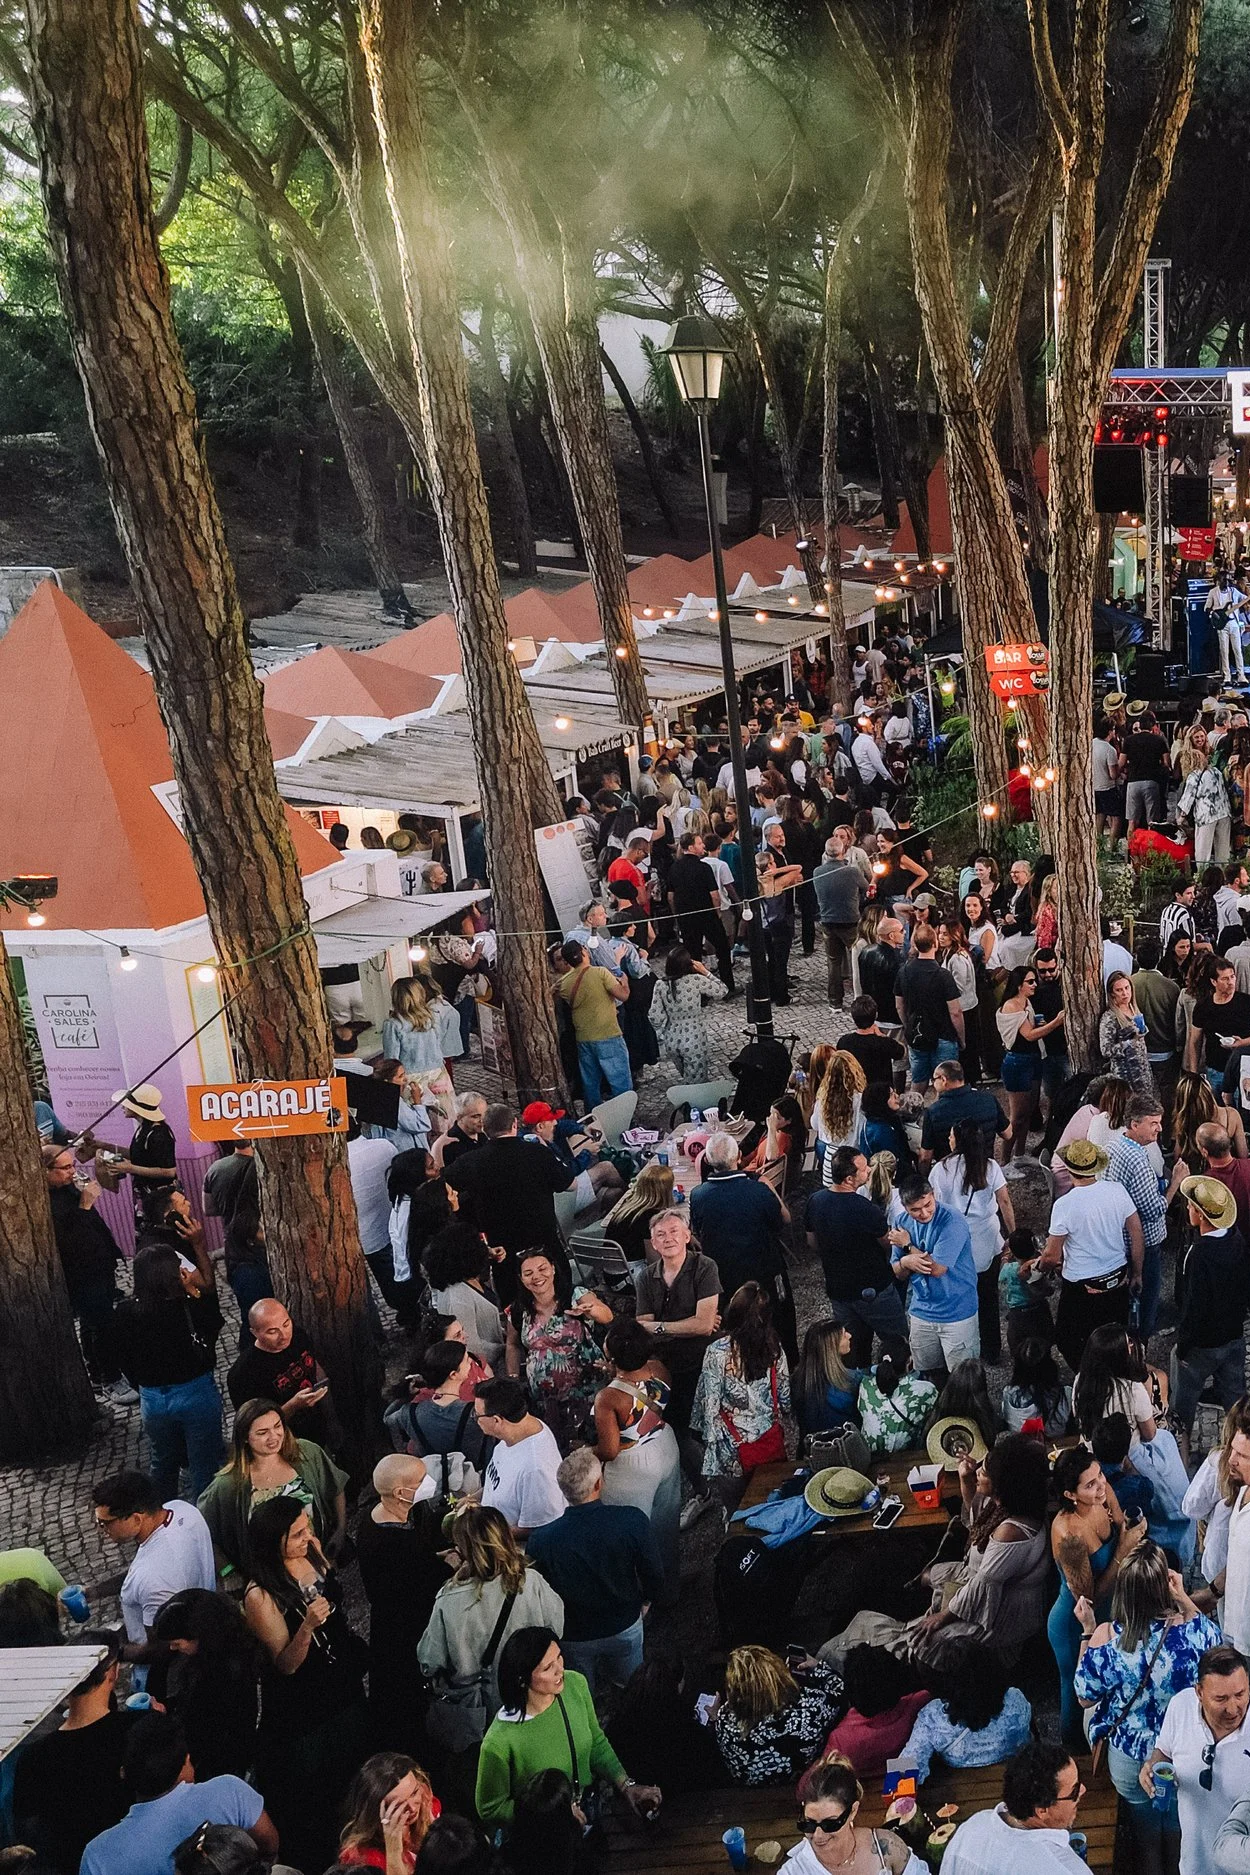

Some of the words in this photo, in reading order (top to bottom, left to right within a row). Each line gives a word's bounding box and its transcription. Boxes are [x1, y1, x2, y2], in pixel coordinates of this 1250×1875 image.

[993, 650, 1022, 664] BAR
[998, 677, 1024, 690] WC
[42, 1009, 97, 1017] CAROLINA
[54, 1018, 90, 1026] SALES
[60, 1027, 91, 1047] café
[200, 1080, 332, 1121] ACARAJÉ
